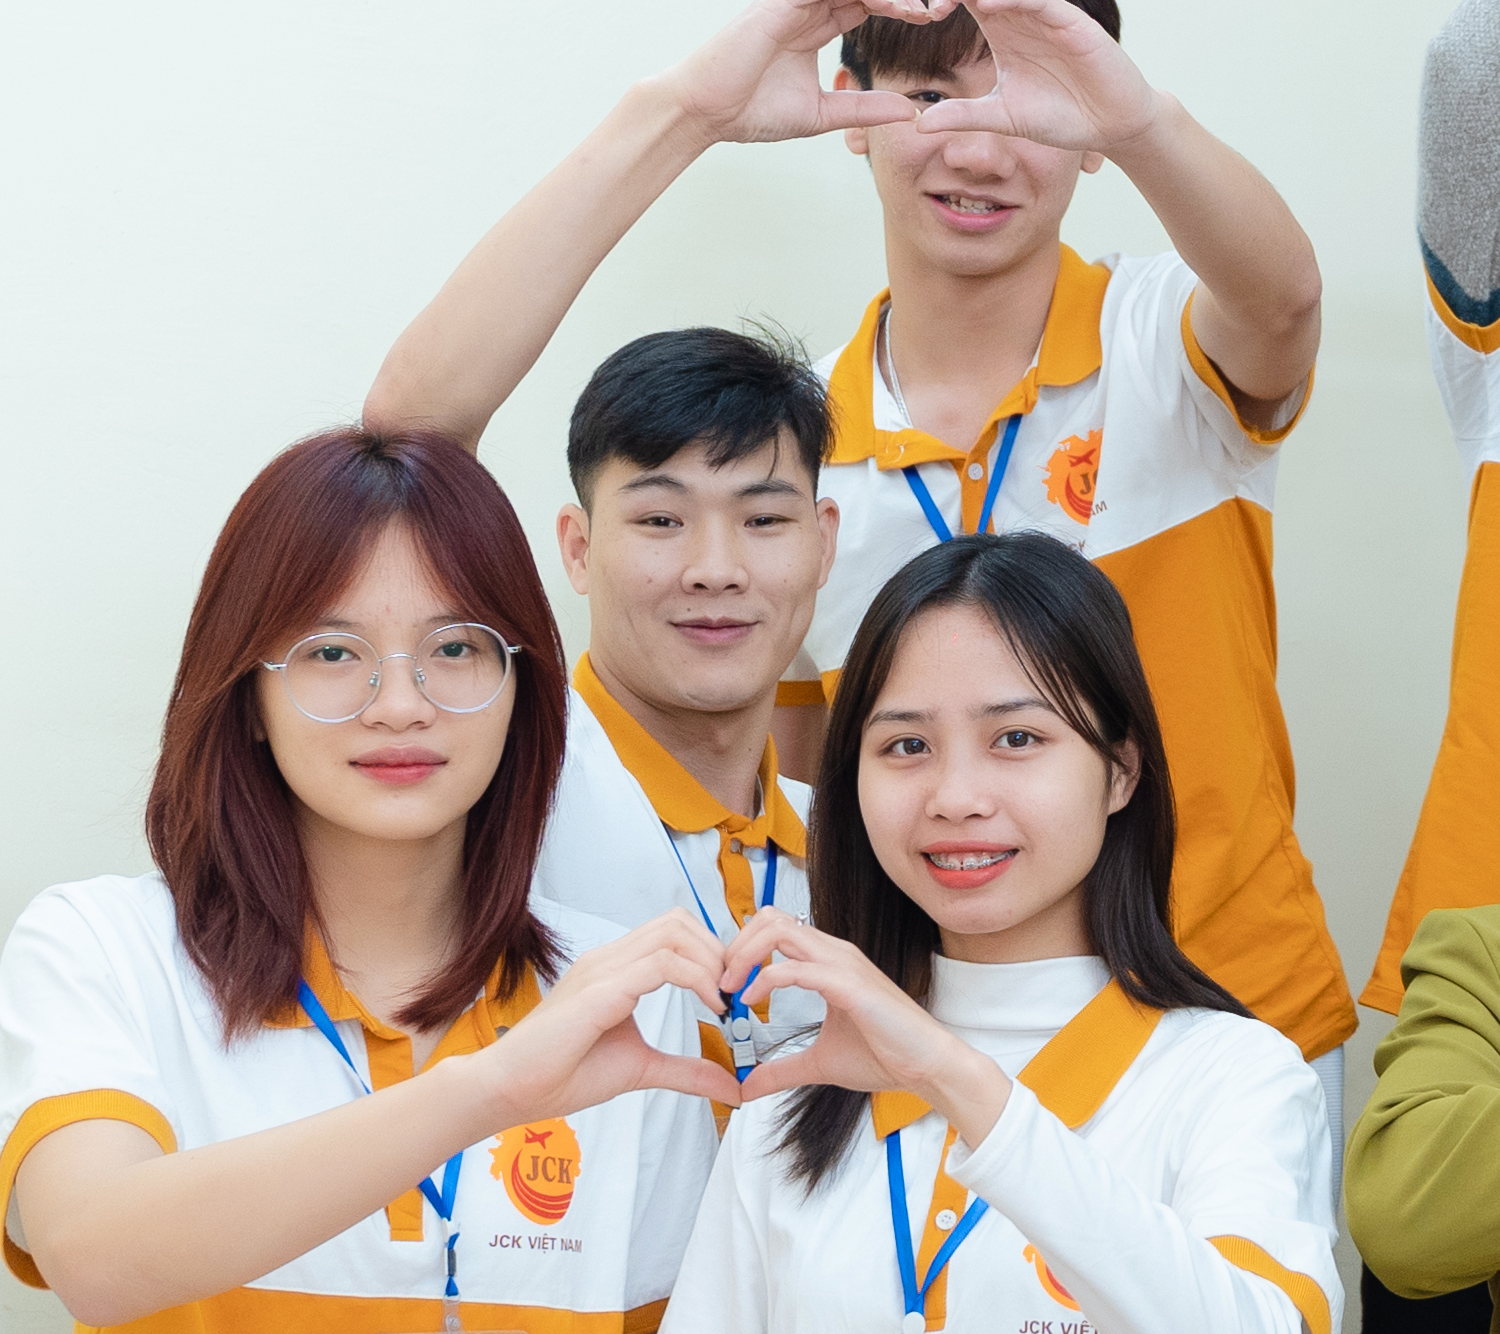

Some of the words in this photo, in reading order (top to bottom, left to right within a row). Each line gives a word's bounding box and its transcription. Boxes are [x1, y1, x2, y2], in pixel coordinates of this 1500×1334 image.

[526, 1155, 573, 1184] JCK
[489, 1234, 522, 1249] JCK
[528, 1233, 557, 1254] VIỆT
[560, 1238, 582, 1253] NAM
[1019, 1320, 1053, 1334] JCK
